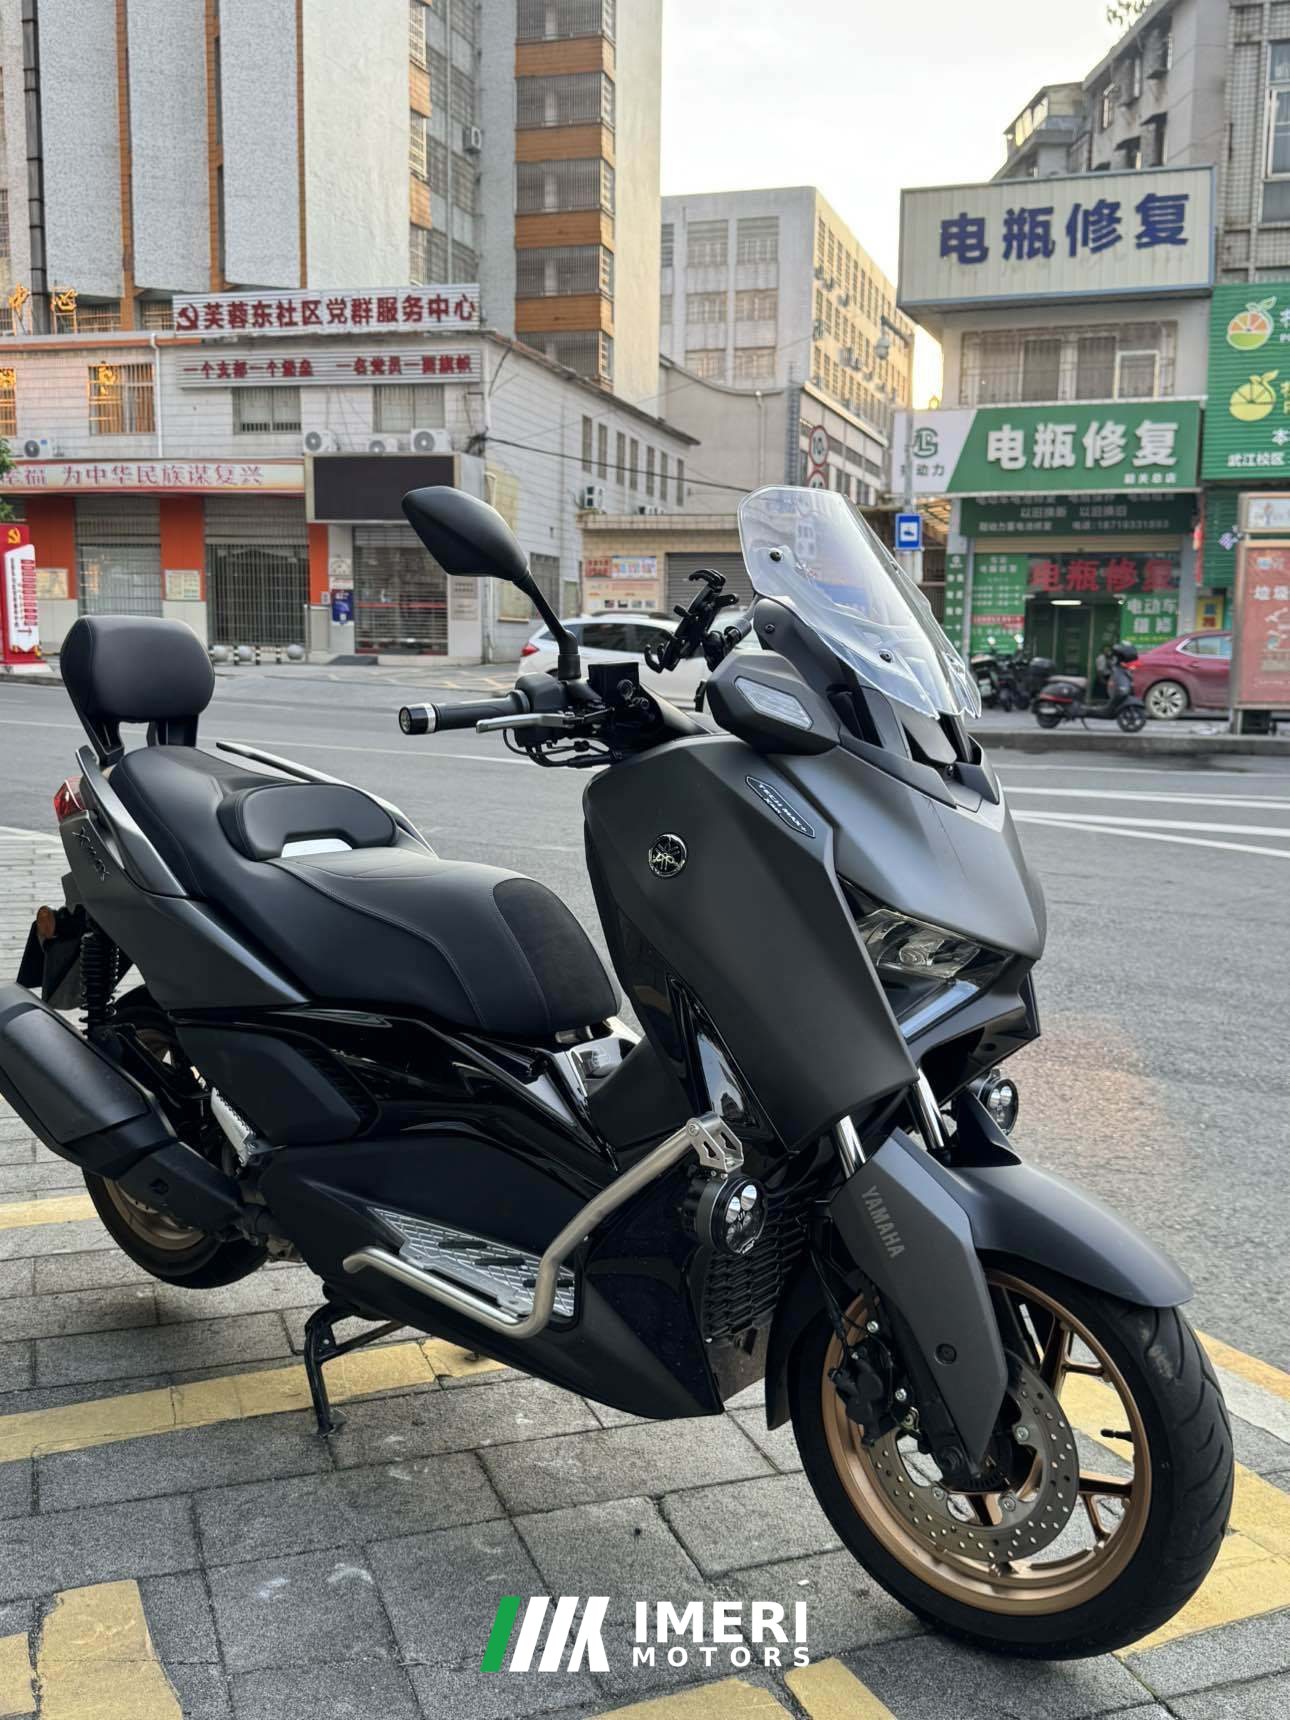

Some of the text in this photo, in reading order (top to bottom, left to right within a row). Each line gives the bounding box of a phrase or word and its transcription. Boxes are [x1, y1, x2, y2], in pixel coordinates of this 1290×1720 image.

[939, 192, 1190, 265] 电瓶修复
[202, 294, 477, 331] 芙蓉东社区党群服务中心
[986, 419, 1179, 472] 电瓶修复
[62, 463, 265, 487] 为中华民族谋复兴
[861, 1184, 905, 1258] YAMAHA
